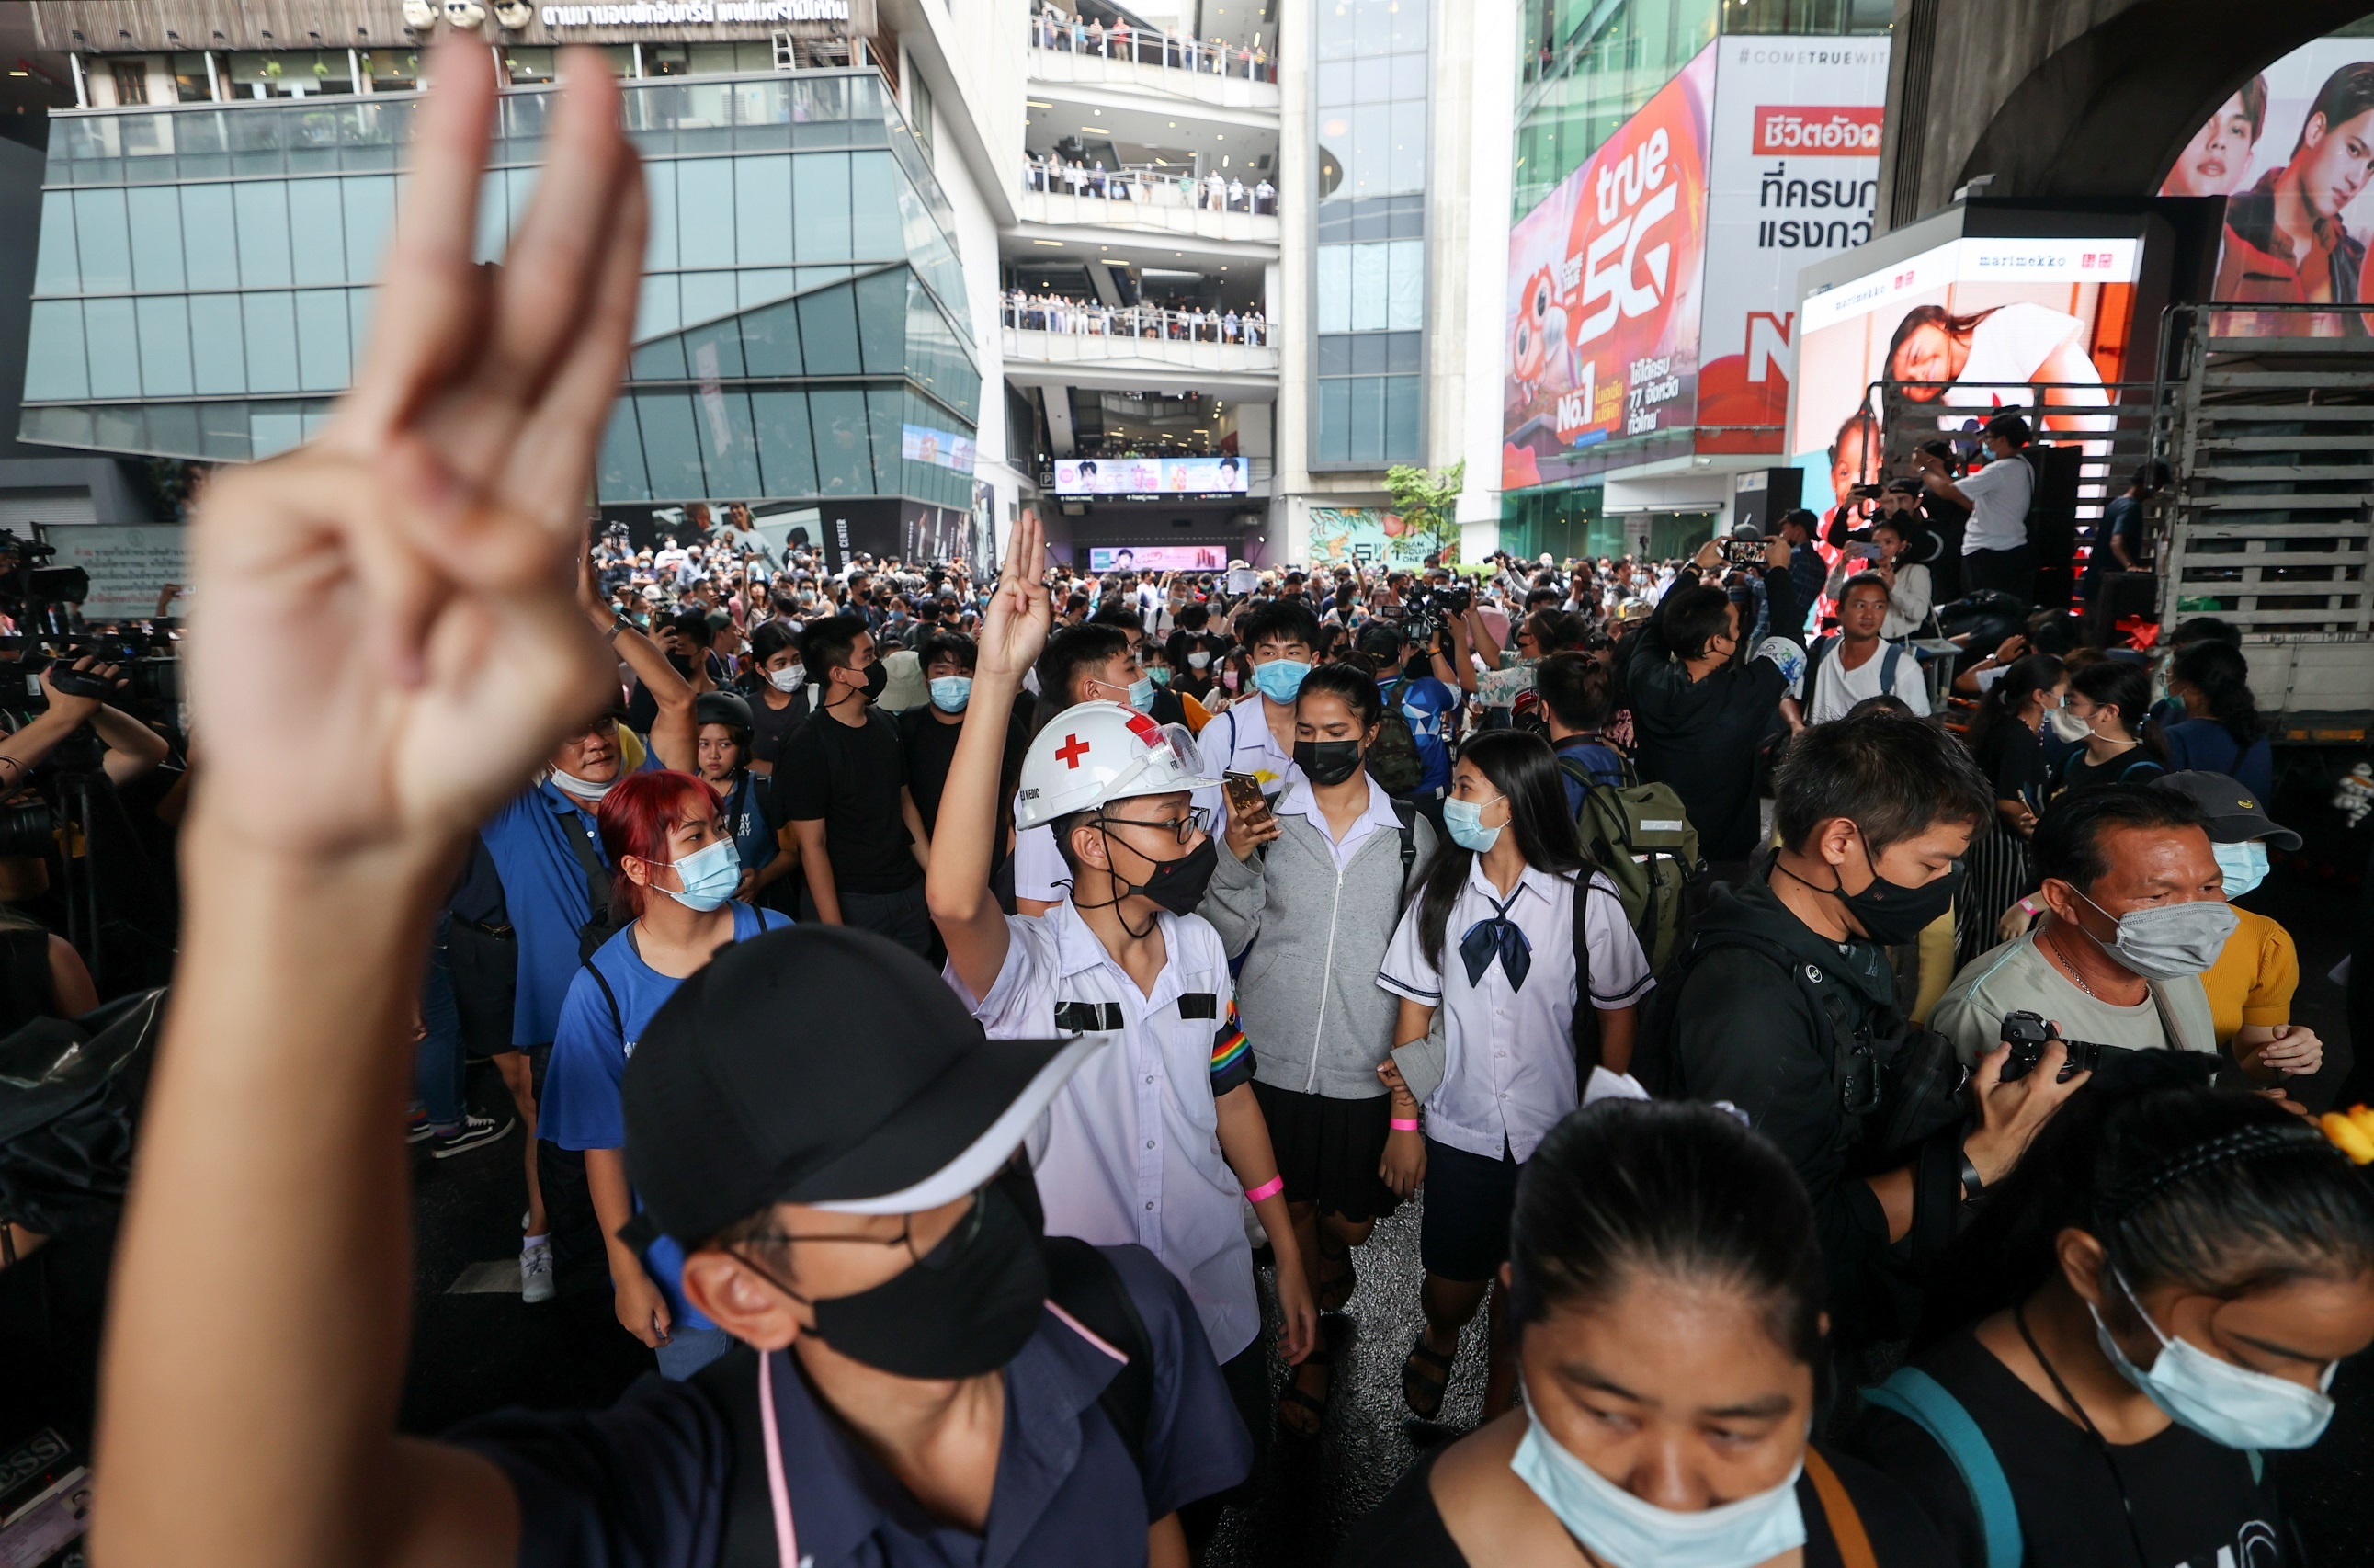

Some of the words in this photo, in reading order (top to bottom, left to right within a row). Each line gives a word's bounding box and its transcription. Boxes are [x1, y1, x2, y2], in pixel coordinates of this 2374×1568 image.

[1764, 115, 1883, 147] ชีวิตอัจฉ
[1596, 127, 1669, 225] true
[1577, 181, 1678, 347] 5G
[1980, 255, 2066, 267] marimekko
[1629, 388, 1642, 410] 77
[1644, 375, 1679, 405] จังหวัด
[836, 518, 849, 548] CENTER
